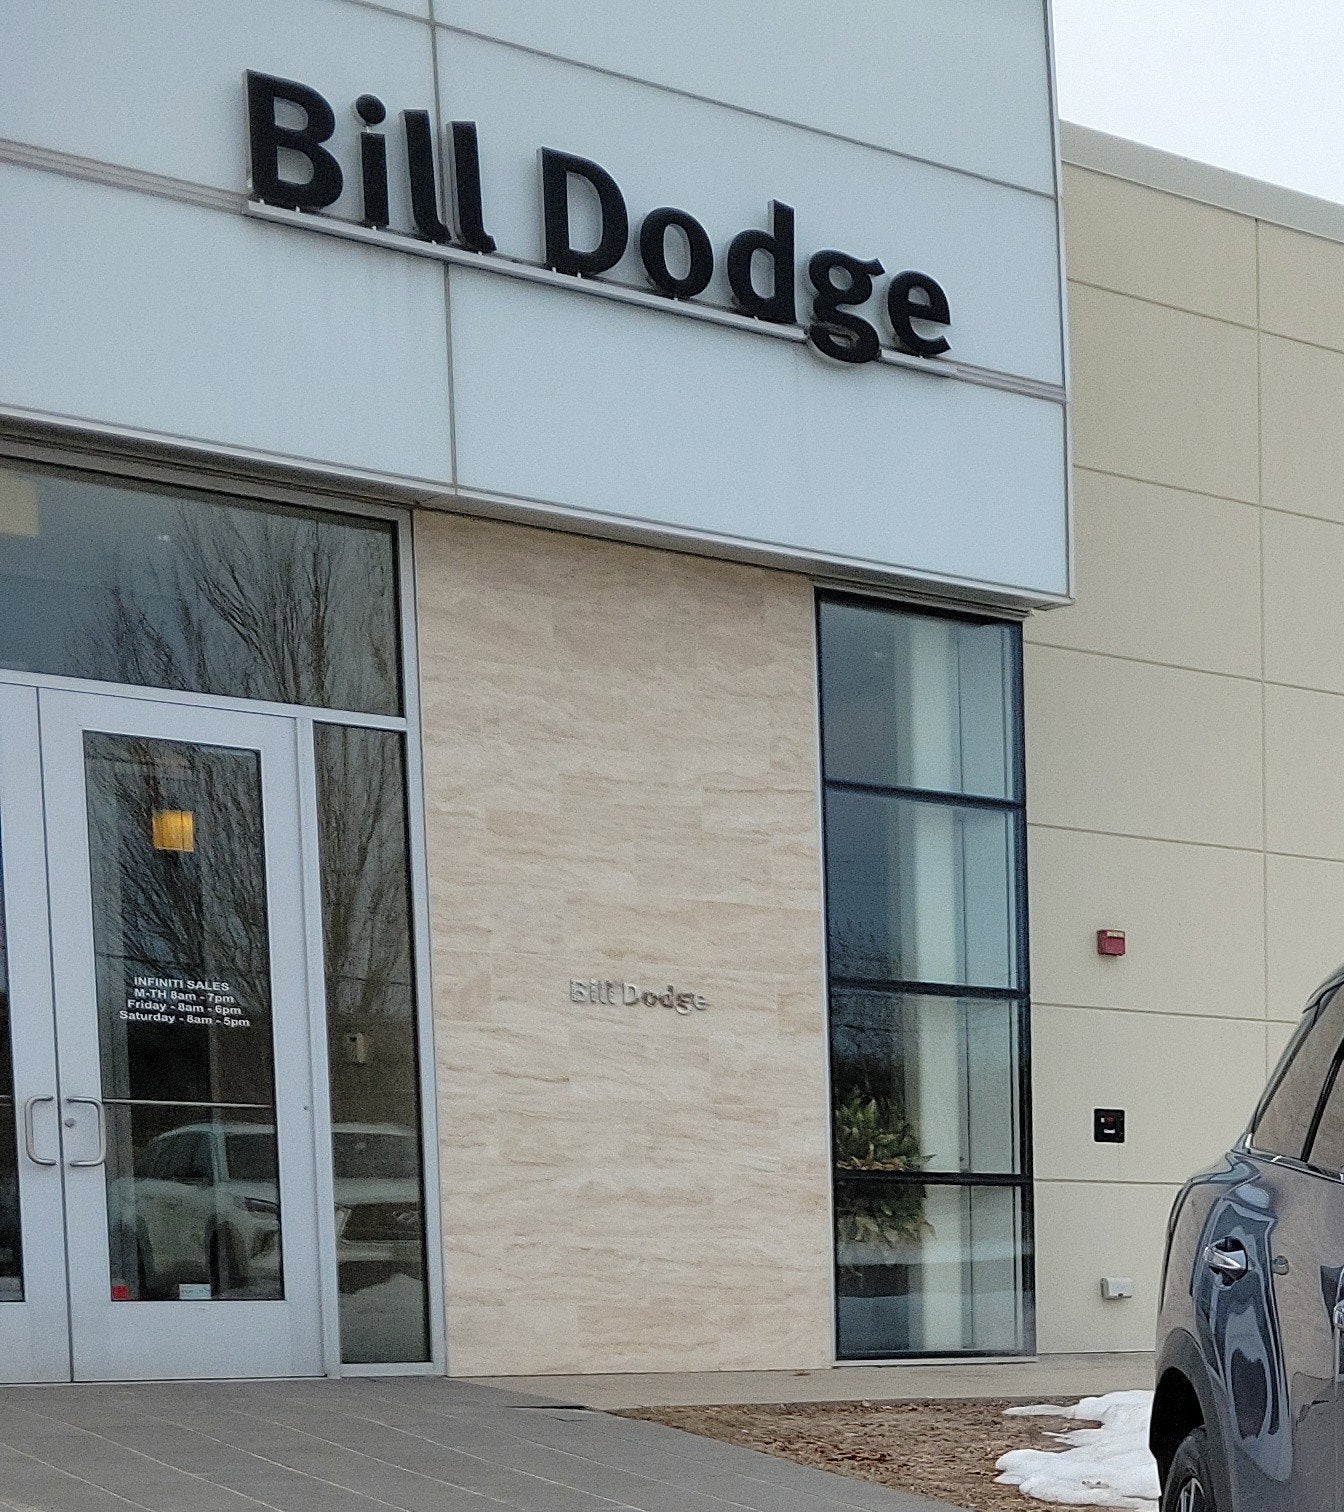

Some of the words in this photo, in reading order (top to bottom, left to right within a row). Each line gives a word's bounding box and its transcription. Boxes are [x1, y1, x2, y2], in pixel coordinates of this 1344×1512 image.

[245, 69, 496, 254] Bill
[539, 147, 953, 363] Dodge
[134, 977, 184, 988] INFINITI
[187, 980, 230, 991] SALES
[134, 989, 168, 999] M-TH
[170, 991, 197, 1001] 8am
[207, 993, 235, 1004] 7pm
[570, 978, 618, 1006] Bill
[622, 982, 709, 1016] Dodge
[127, 999, 167, 1012] Friday
[178, 1003, 205, 1013] 8am
[214, 1005, 242, 1016] 6pm
[119, 1010, 176, 1024] Saturday
[186, 1015, 213, 1024] 8am
[223, 1017, 251, 1028] 5pm
